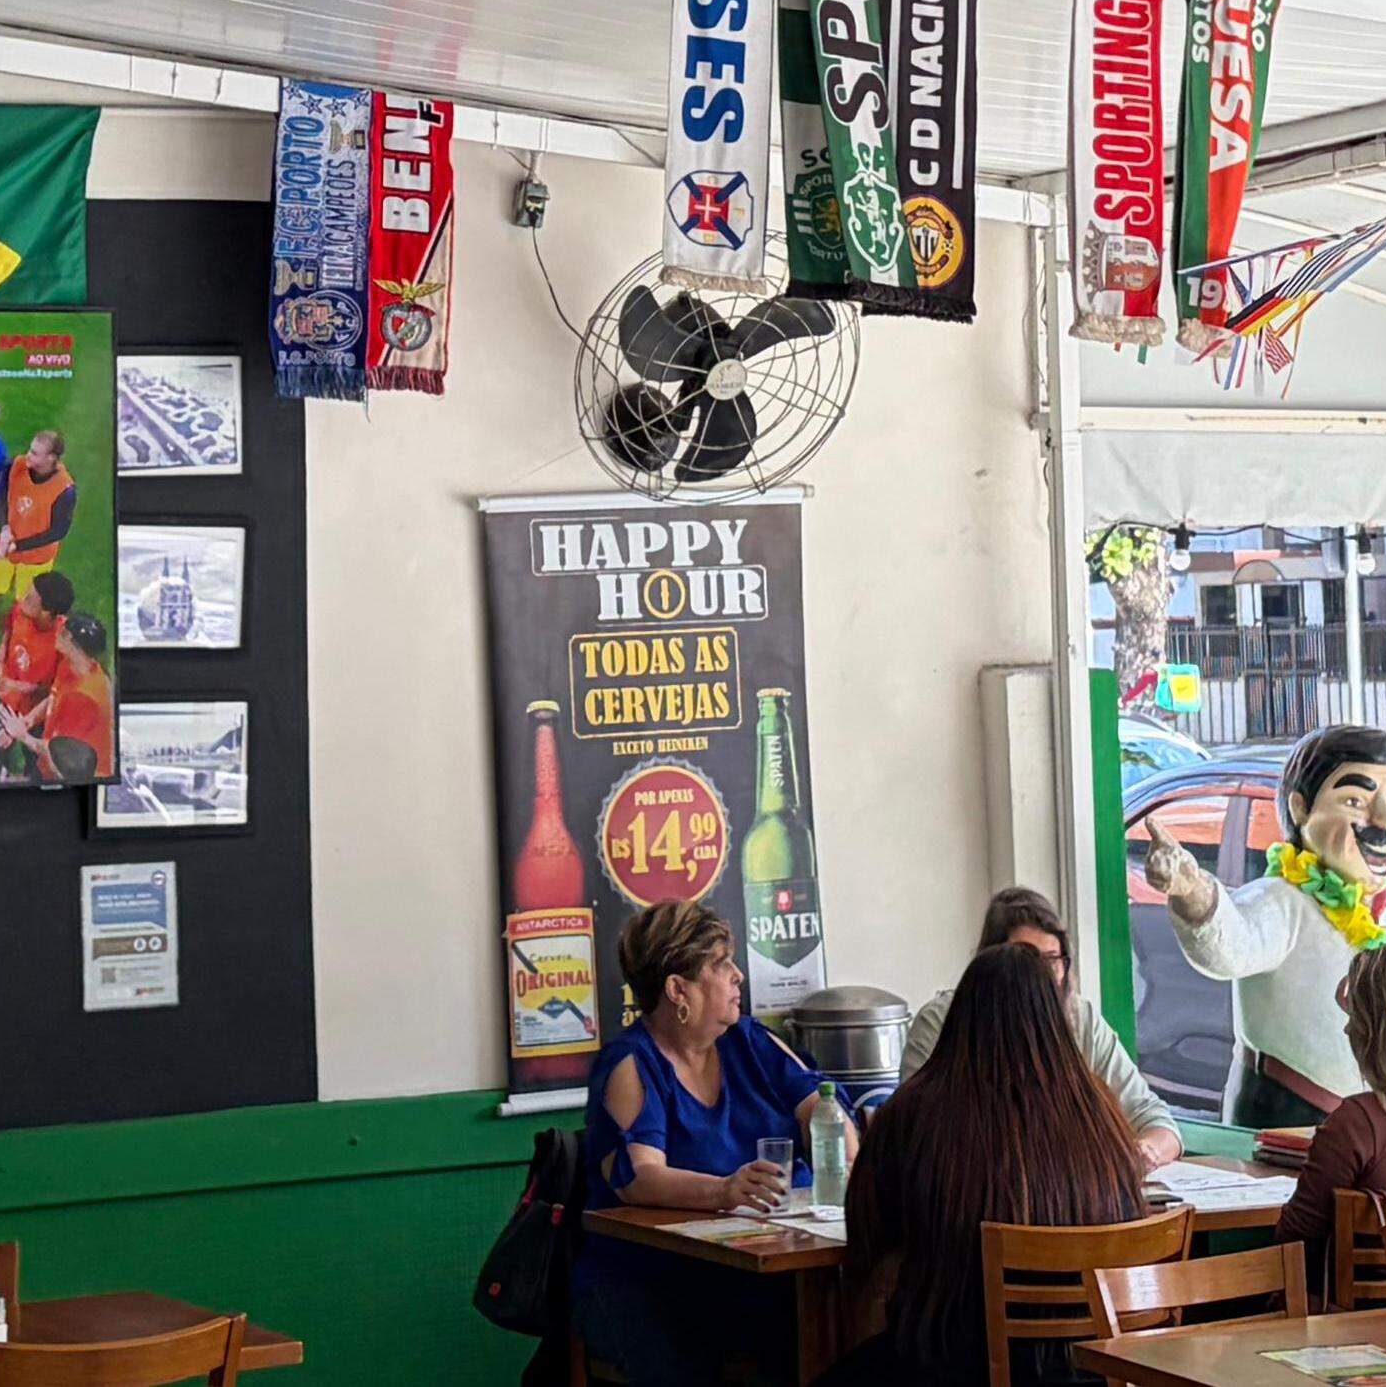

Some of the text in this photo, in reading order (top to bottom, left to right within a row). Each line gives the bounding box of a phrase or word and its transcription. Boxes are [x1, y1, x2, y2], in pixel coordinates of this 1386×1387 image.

[910, 118, 940, 150] D
[909, 159, 939, 187] C
[539, 519, 748, 571] HAPPY
[596, 568, 763, 620] HOUR
[579, 635, 730, 678] TODAS AS
[584, 682, 730, 725] CERVEJAS
[613, 741, 654, 755] EXCETO
[771, 735, 785, 789] SPATEN
[634, 792, 656, 806] POR
[515, 918, 584, 931] ANTARCTICA
[516, 969, 592, 998] ORIGINAL
